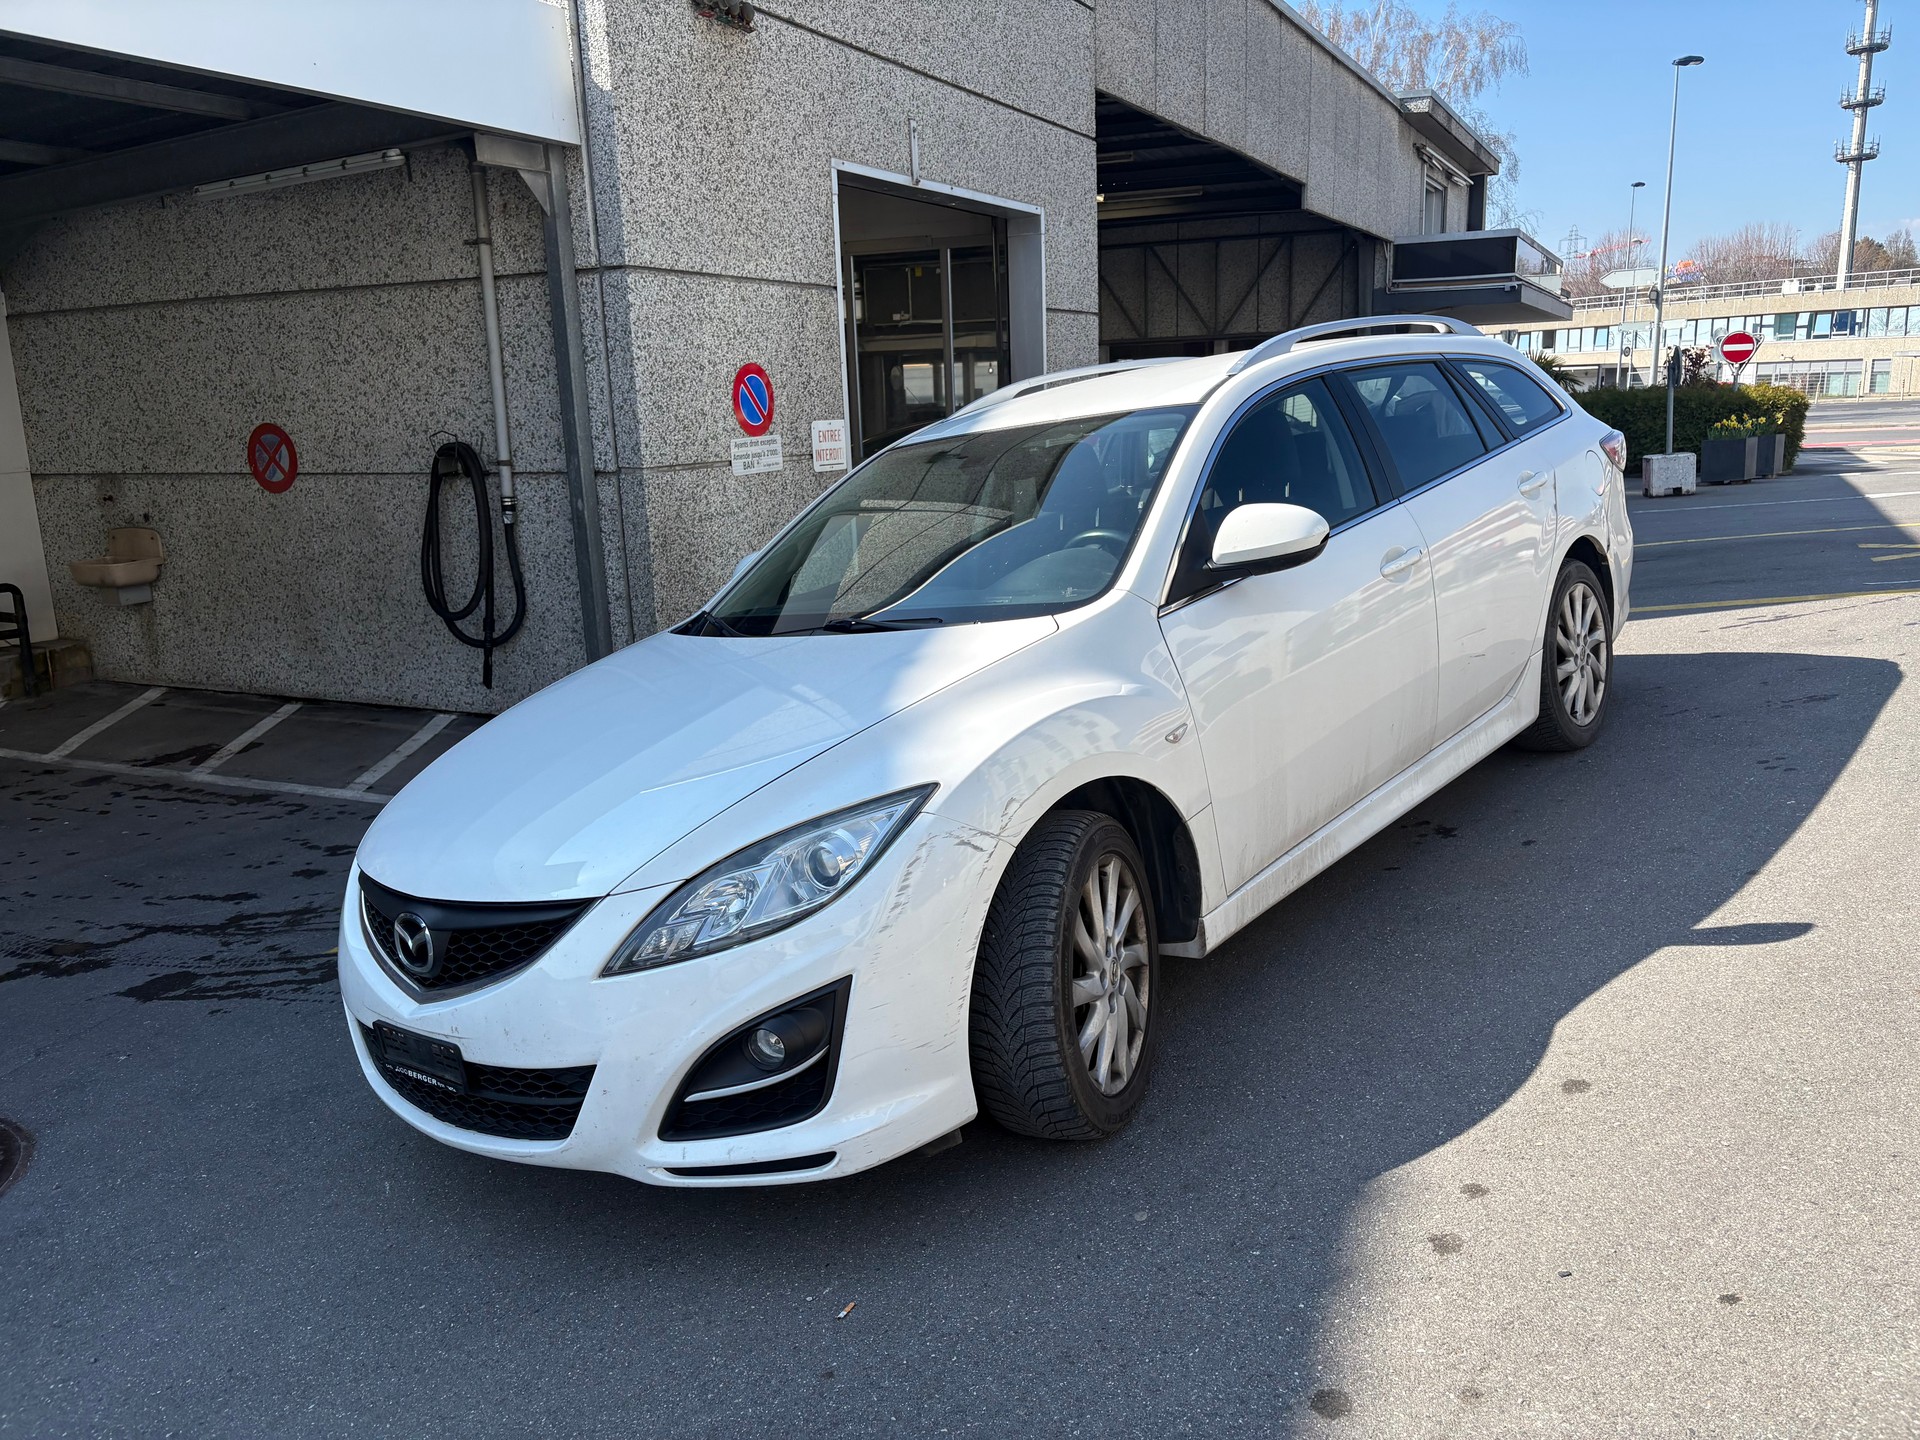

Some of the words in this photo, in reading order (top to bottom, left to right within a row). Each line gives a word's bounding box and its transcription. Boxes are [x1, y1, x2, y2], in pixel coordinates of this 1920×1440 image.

[818, 429, 842, 443] ENTREE
[749, 439, 759, 447] droit
[733, 452, 750, 461] Amende
